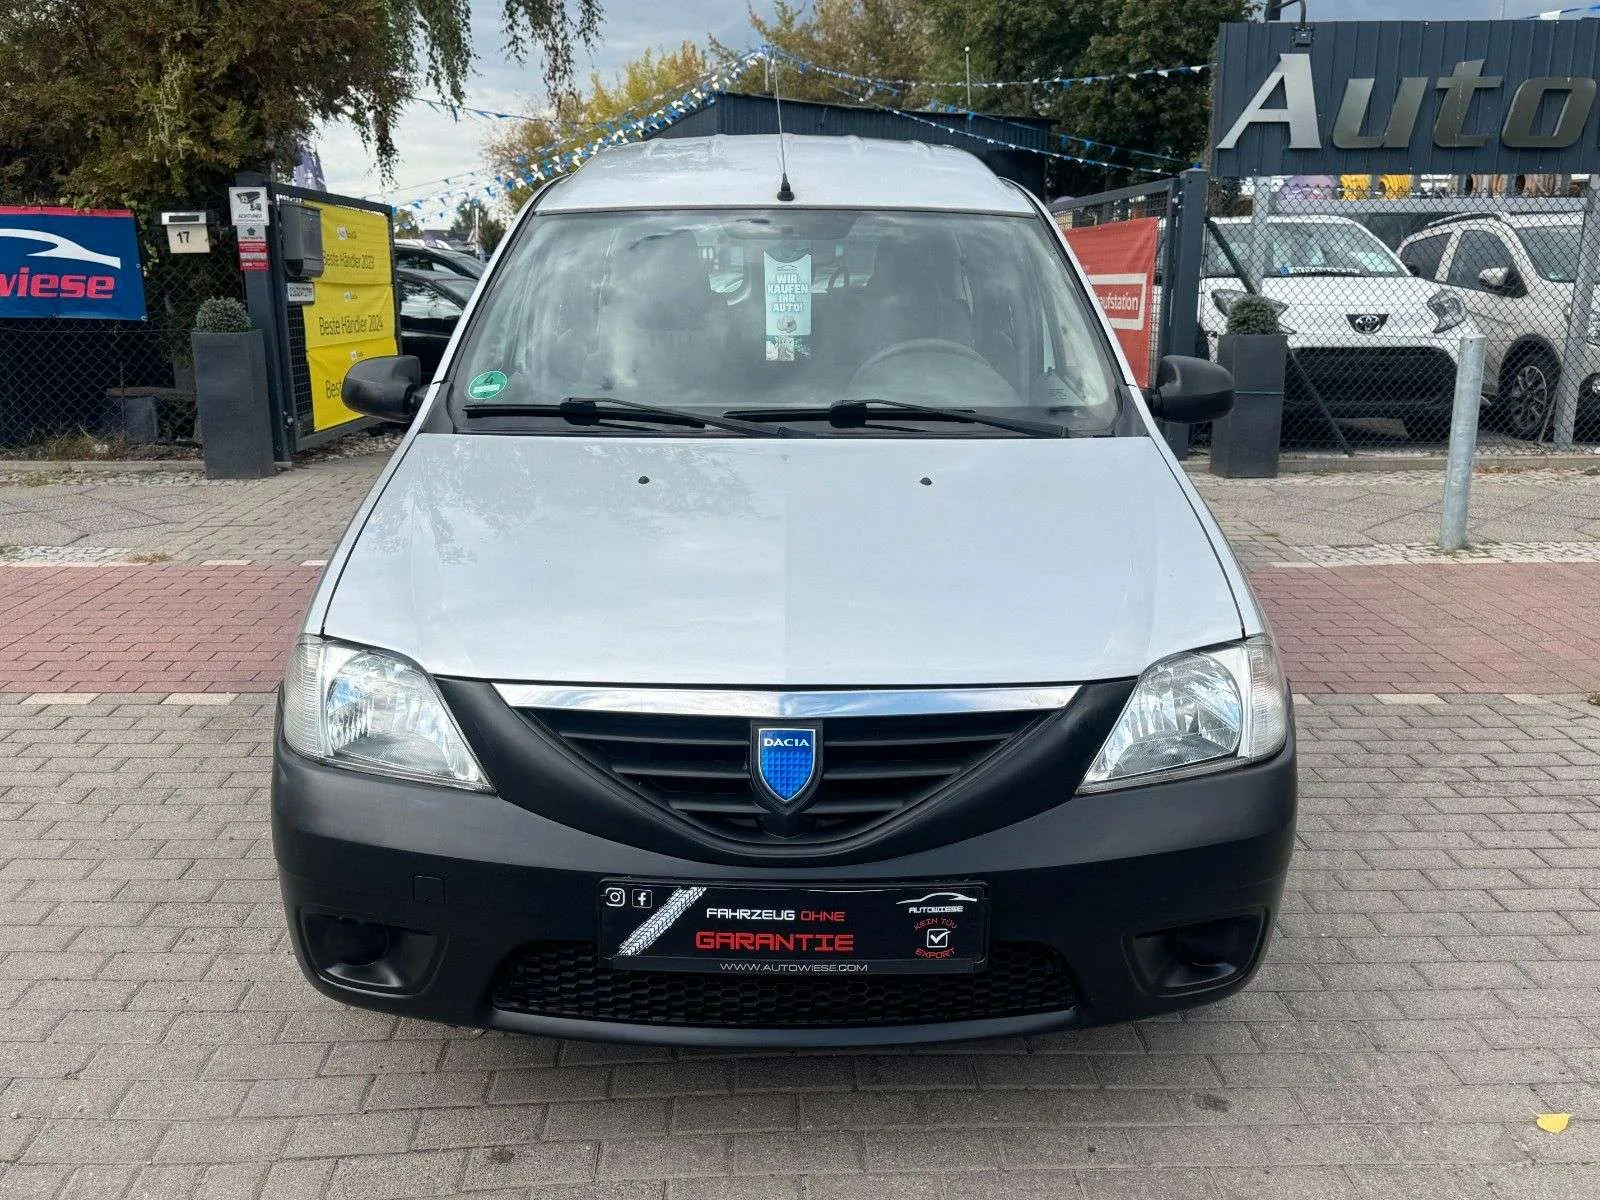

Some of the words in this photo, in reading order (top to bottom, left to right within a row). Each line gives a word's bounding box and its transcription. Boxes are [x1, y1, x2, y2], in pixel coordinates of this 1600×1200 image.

[1215, 53, 1598, 149] Auto
[176, 231, 190, 244] 17
[776, 274, 798, 284] WIR
[767, 284, 809, 294] KAUFEN
[319, 317, 340, 335] Beste
[341, 315, 367, 334] Händler
[368, 314, 384, 332] 2024
[484, 373, 494, 385] 4
[763, 738, 810, 747] DACIA
[706, 908, 796, 921] FAHRZEUG
[800, 911, 846, 922] OHNE
[908, 905, 964, 914] AUTOWIESE
[695, 931, 854, 952] GARANTIE
[914, 947, 955, 959] EXPORT
[719, 962, 868, 972] WWW.AUTOWIESE.COM
